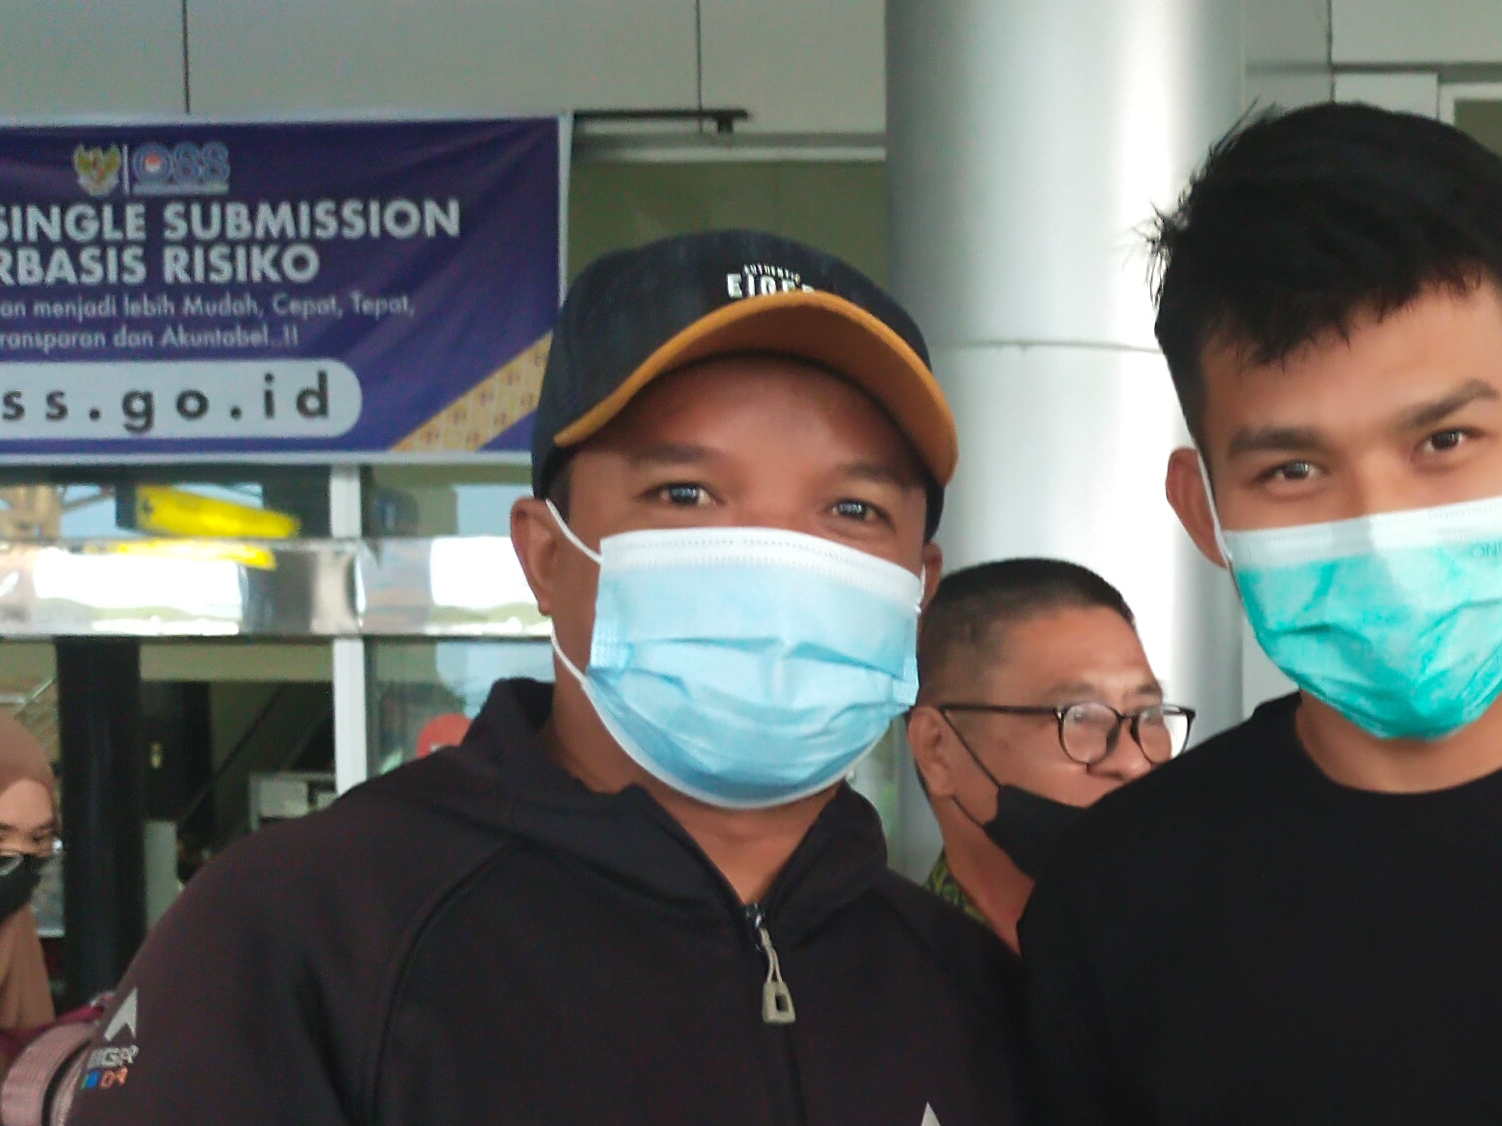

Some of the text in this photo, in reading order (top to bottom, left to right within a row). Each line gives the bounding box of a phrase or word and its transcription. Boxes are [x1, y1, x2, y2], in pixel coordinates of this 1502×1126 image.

[163, 199, 461, 240] SUBMISSION
[163, 244, 320, 284] RISIKO
[33, 294, 117, 324] menjadi
[124, 292, 176, 317] lebih
[182, 292, 264, 318] Mudah,
[272, 293, 343, 320] Cepat,
[350, 290, 415, 321] Tepat,
[113, 322, 154, 347] dan
